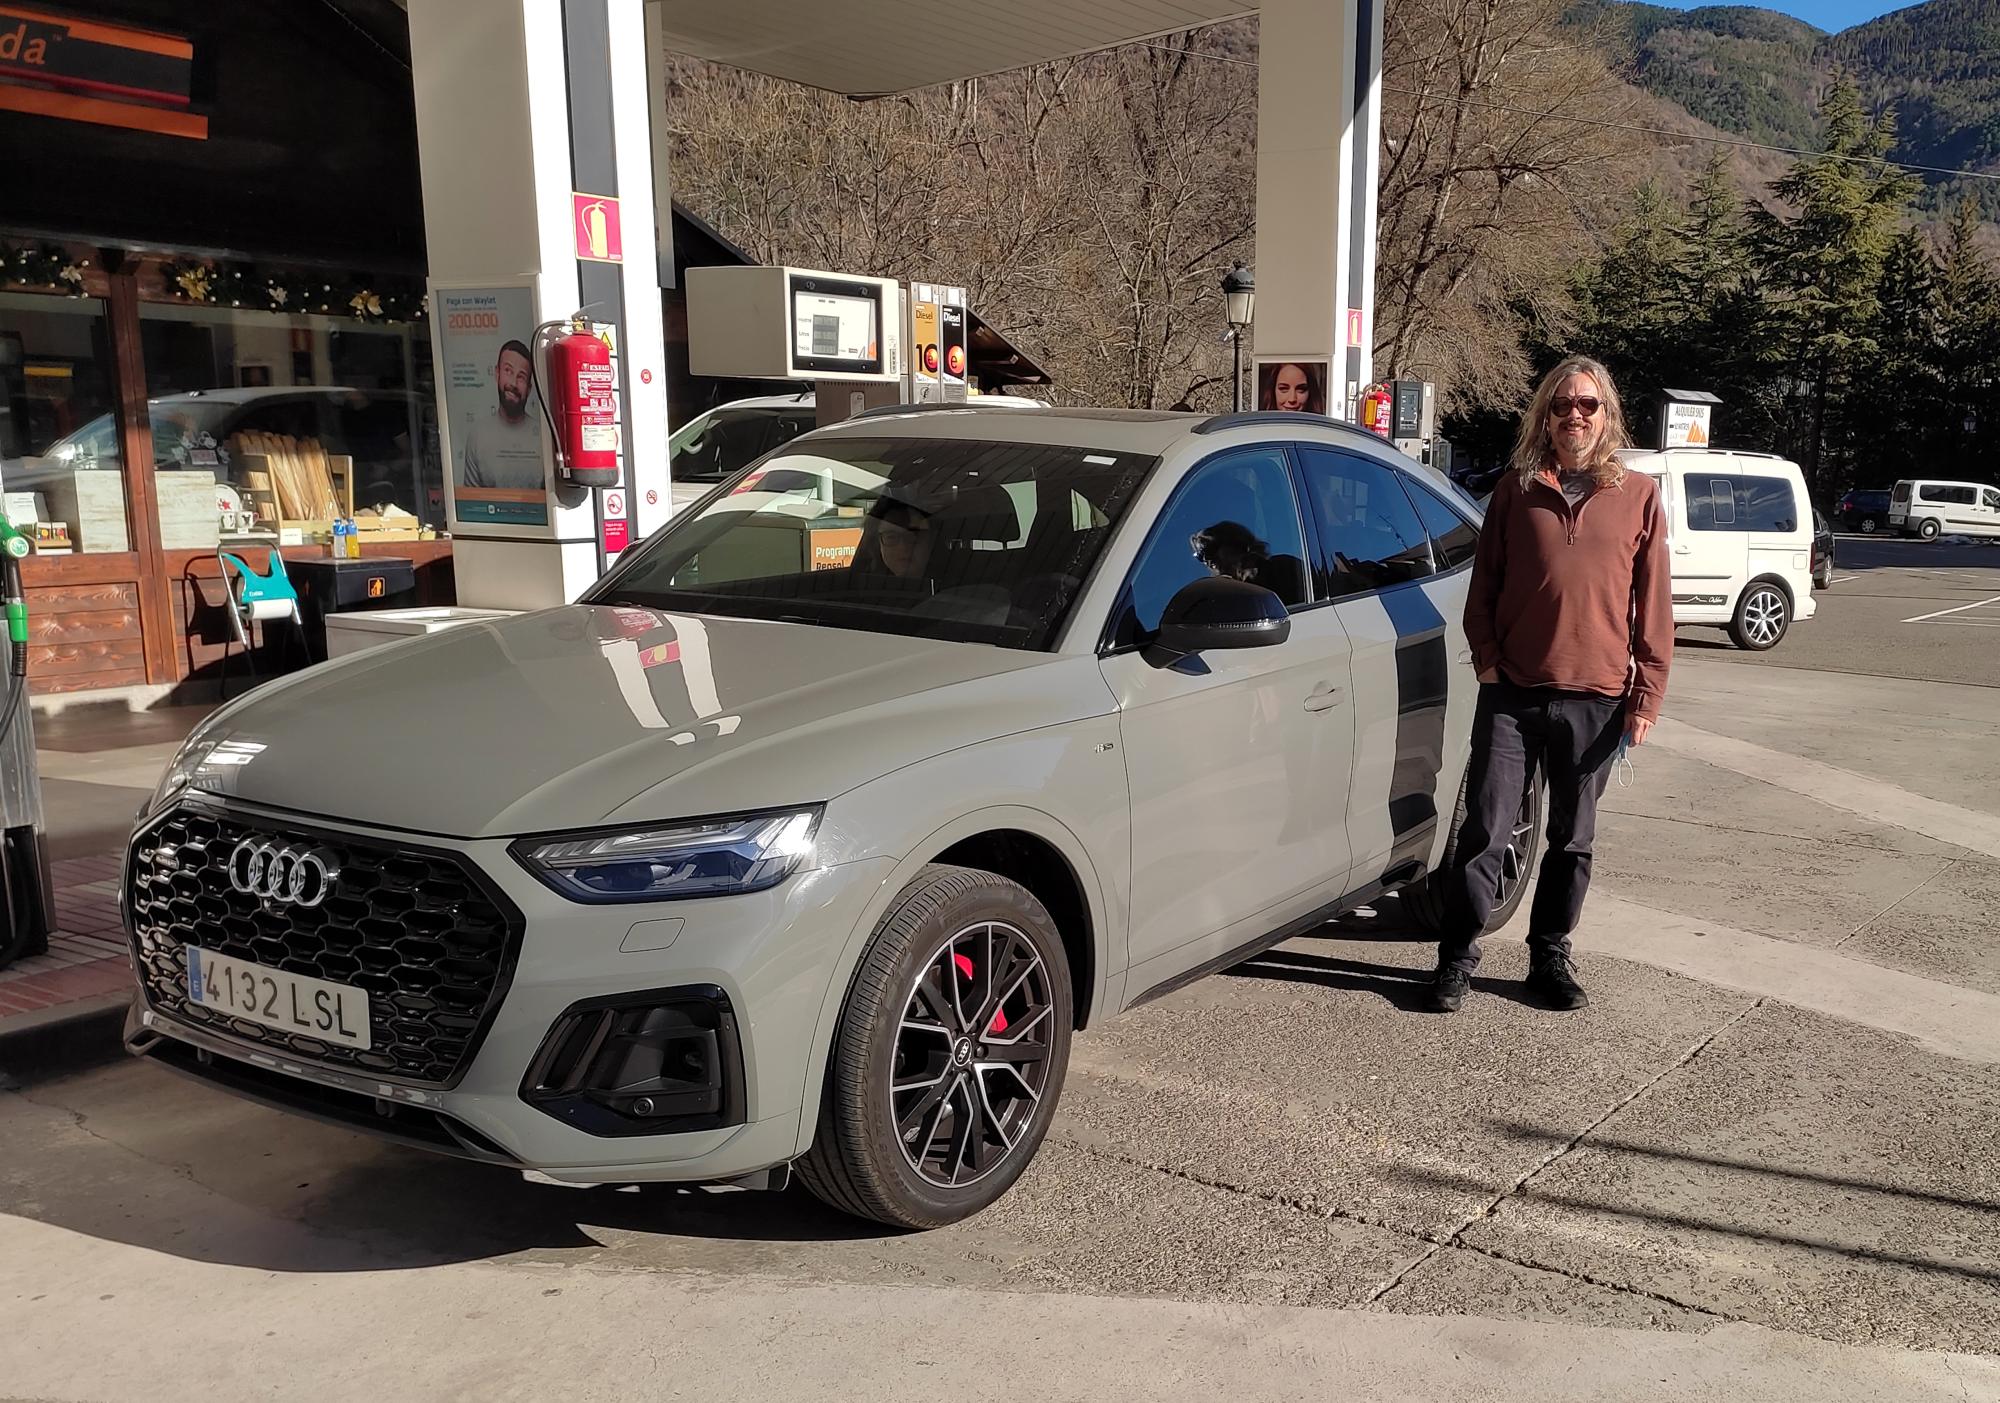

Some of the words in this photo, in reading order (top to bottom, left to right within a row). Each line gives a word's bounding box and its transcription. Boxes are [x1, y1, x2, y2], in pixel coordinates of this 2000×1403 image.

[448, 313, 499, 329] 200.000
[915, 309, 934, 320] Diesel
[943, 312, 961, 323] Diesel
[815, 546, 856, 559] Programa
[205, 961, 279, 1020] 4132
[291, 982, 357, 1038] LSL
